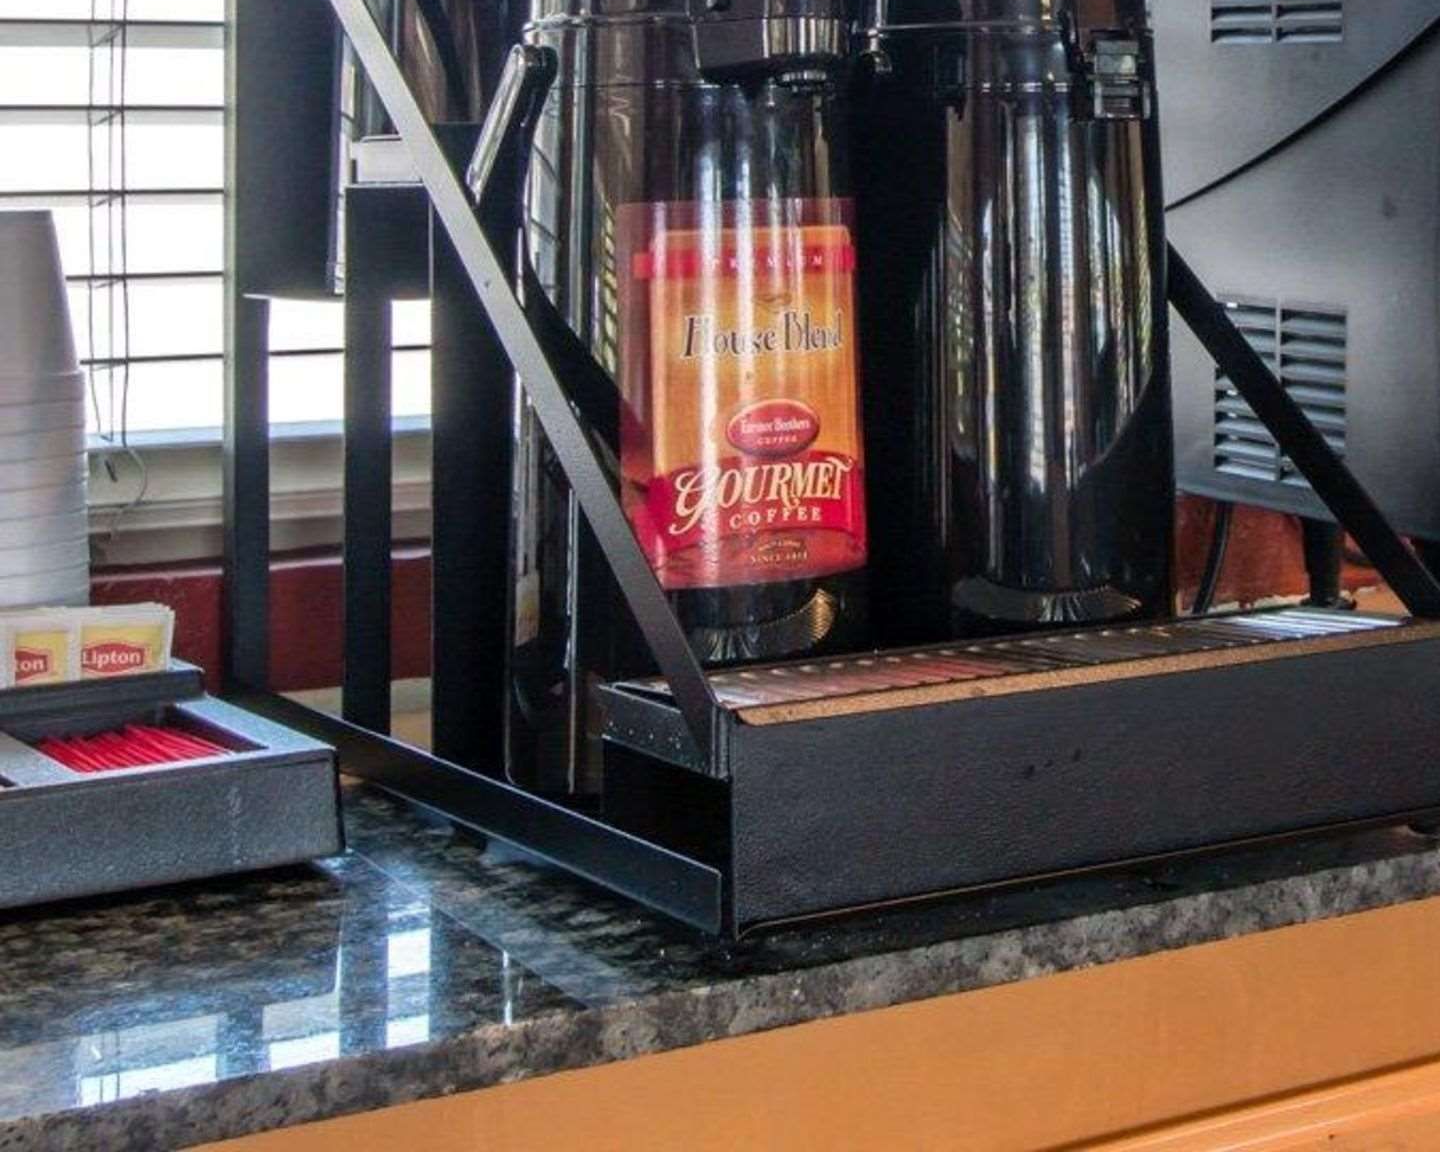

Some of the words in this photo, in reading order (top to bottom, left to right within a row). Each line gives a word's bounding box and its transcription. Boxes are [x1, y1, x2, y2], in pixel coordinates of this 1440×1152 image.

[681, 314, 776, 358] House
[782, 307, 844, 352] Blend
[668, 456, 852, 535] GOURMET
[729, 507, 823, 530] COFFEE
[82, 650, 141, 669] Lipton
